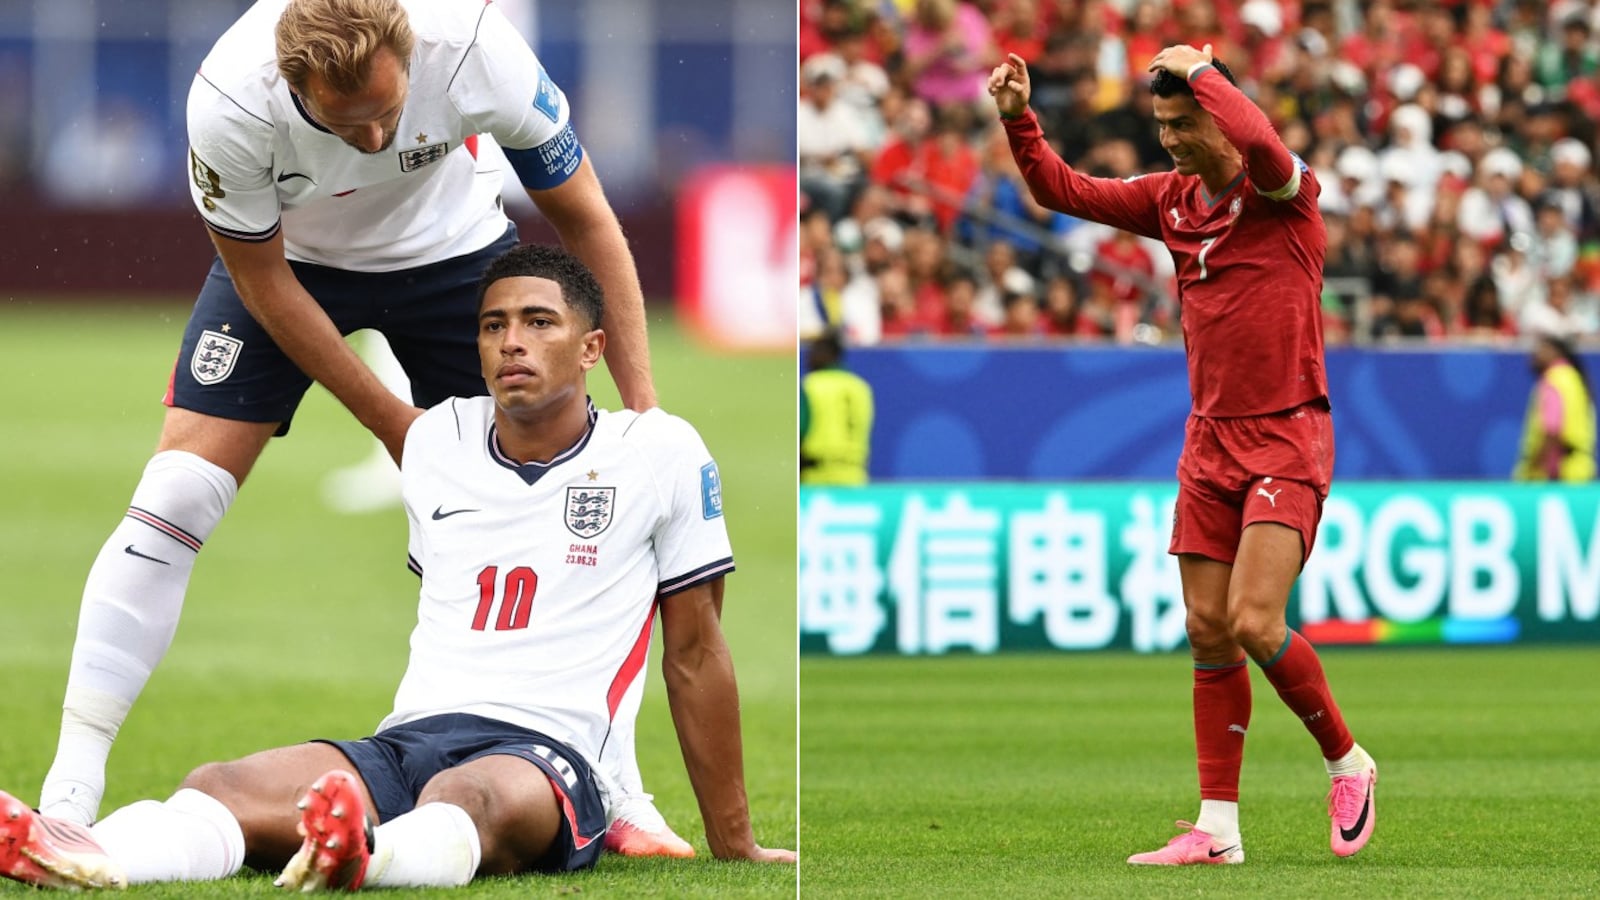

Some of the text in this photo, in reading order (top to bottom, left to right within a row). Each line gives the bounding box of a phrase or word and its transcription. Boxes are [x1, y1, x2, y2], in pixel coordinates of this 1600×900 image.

[541, 126, 574, 165] UNITES
[546, 162, 563, 175] the
[1198, 236, 1218, 280] 7
[569, 543, 597, 554] GHANA
[1299, 493, 1522, 623] RGB
[471, 565, 538, 631] 10
